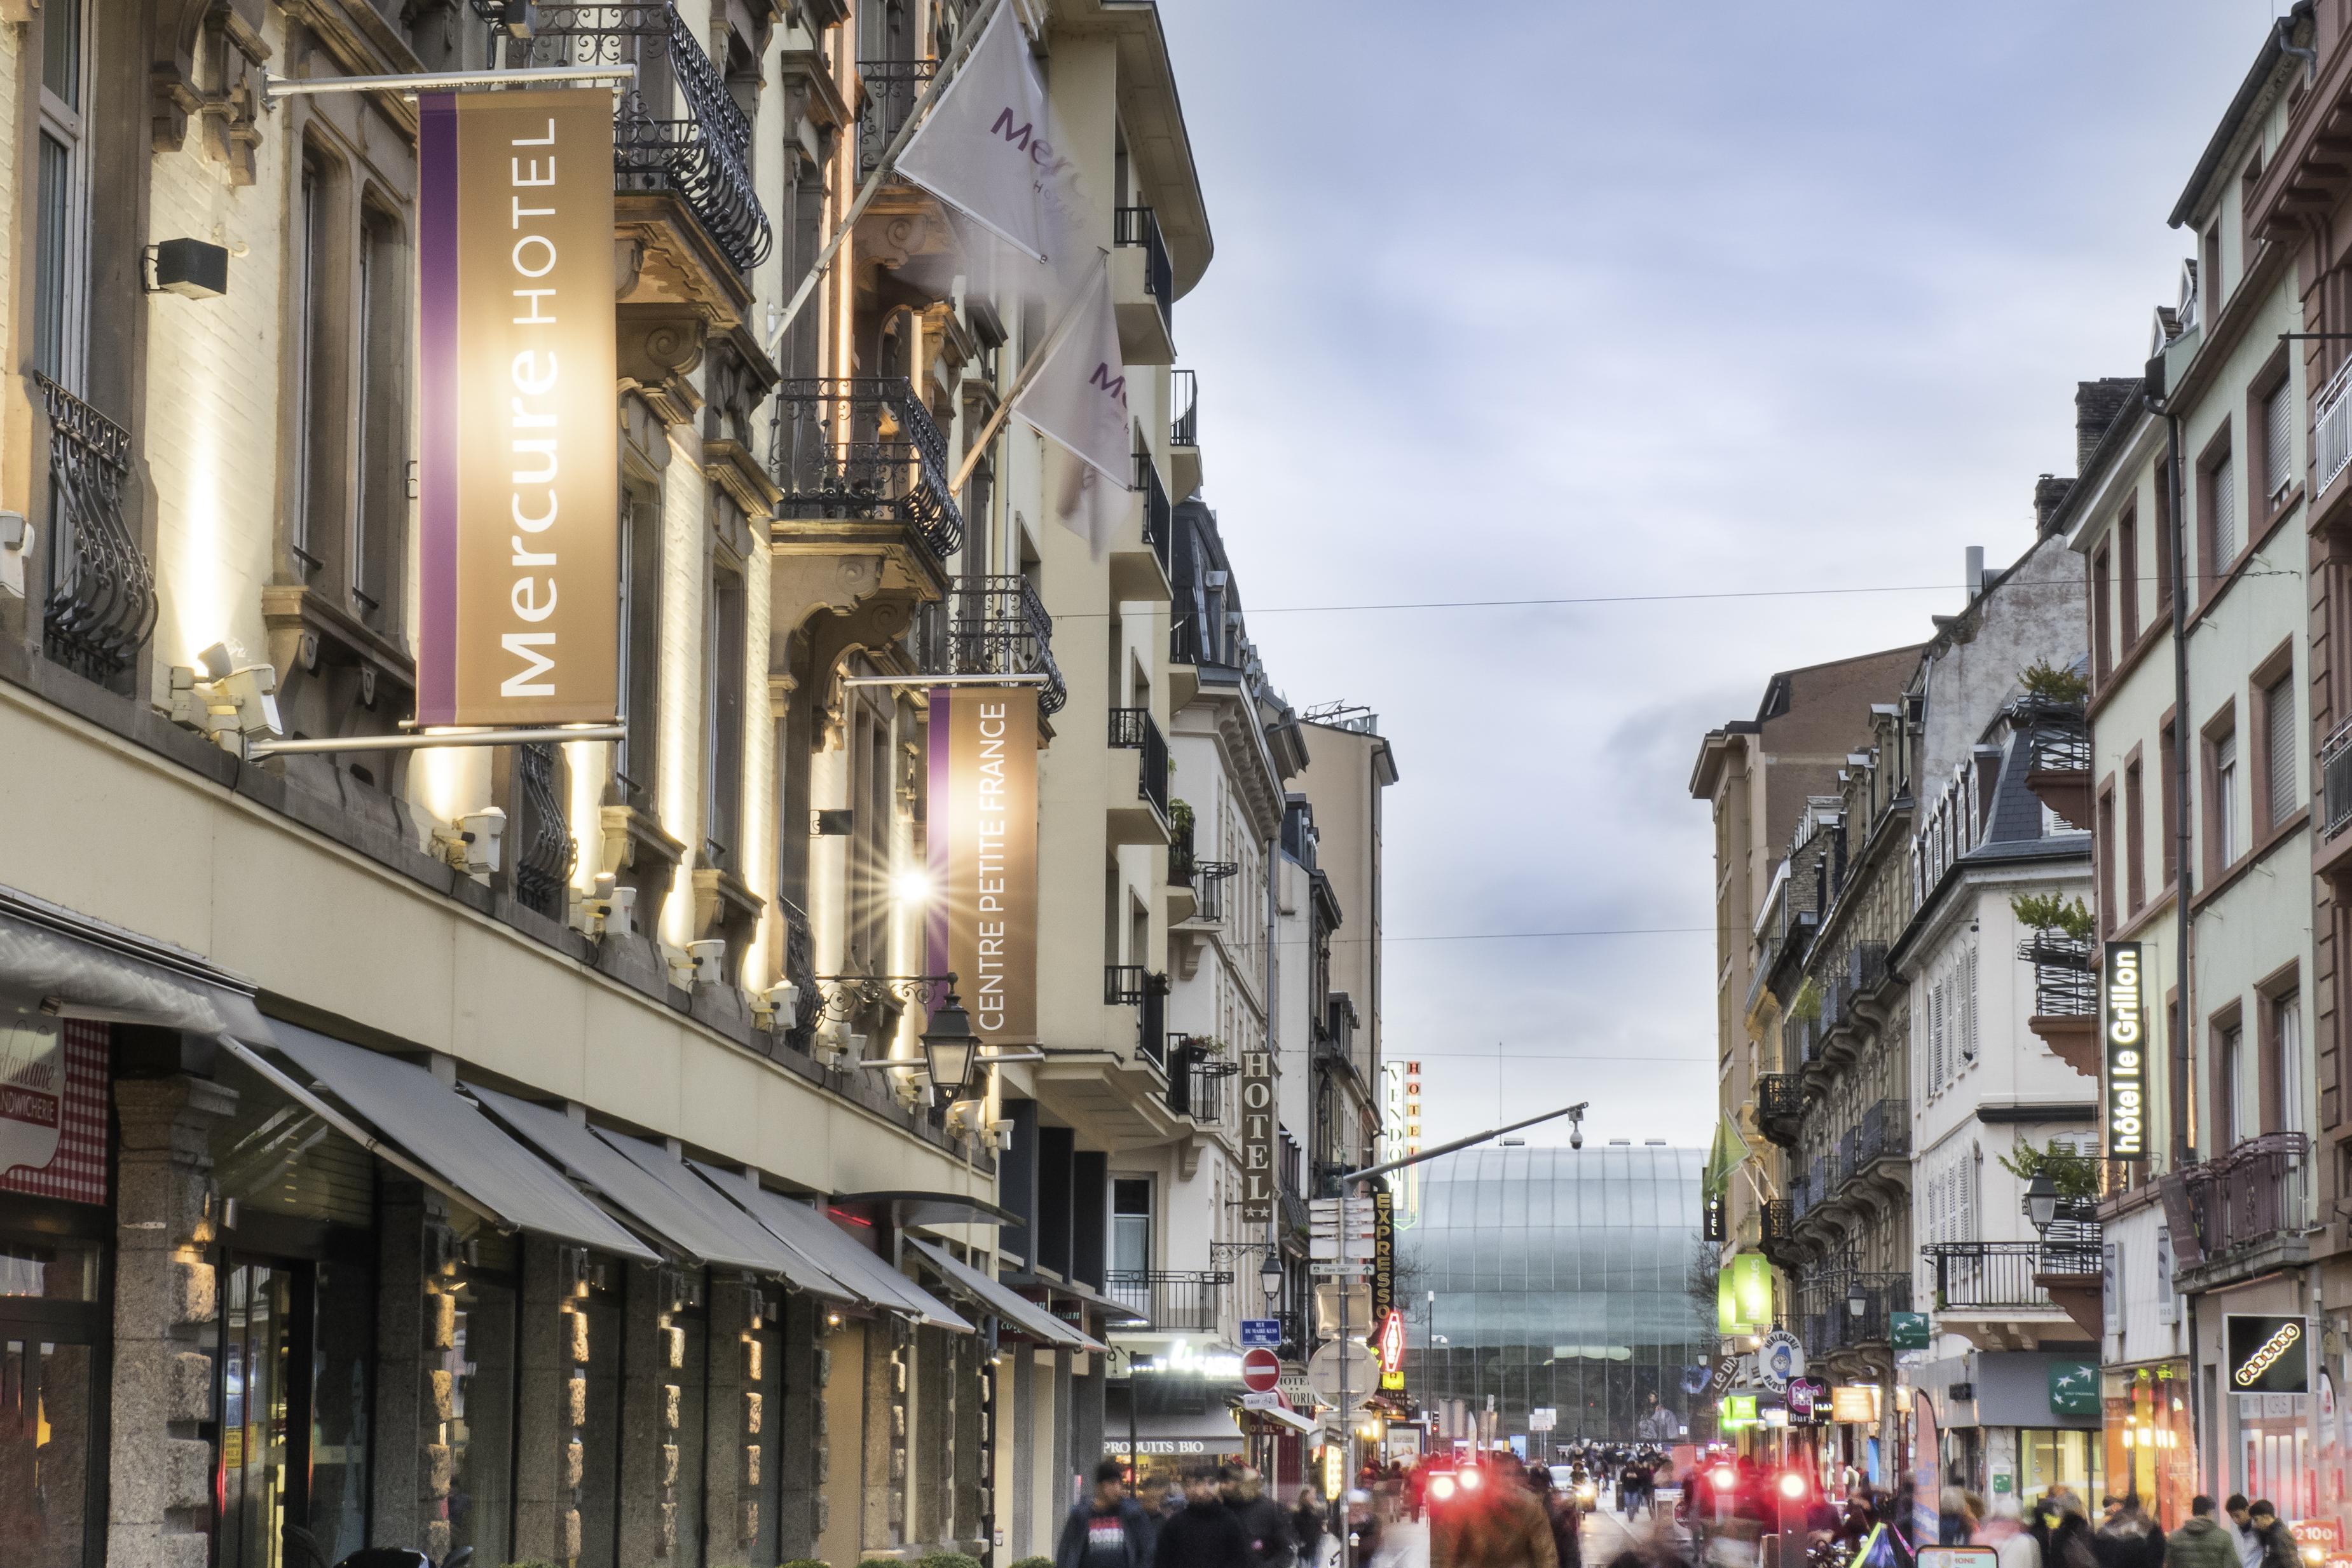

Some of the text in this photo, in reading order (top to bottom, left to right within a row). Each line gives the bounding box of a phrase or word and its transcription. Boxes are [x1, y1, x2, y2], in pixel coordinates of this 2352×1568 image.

[500, 118, 558, 697] Mercure HOTEL
[978, 703, 1006, 1031] CENTRE PETITE FRANCE
[0, 1089, 54, 1122] NDWICHERIE
[2110, 950, 2142, 1154] hôtel le Grillon
[1243, 1053, 1270, 1200] HOTEL
[1376, 1193, 1391, 1320] EXPRESSO
[1764, 1333, 1800, 1351] HORLOGERIE
[2238, 1326, 2297, 1382] FEELING
[1104, 1441, 1204, 1454] PRODUITS BIO
